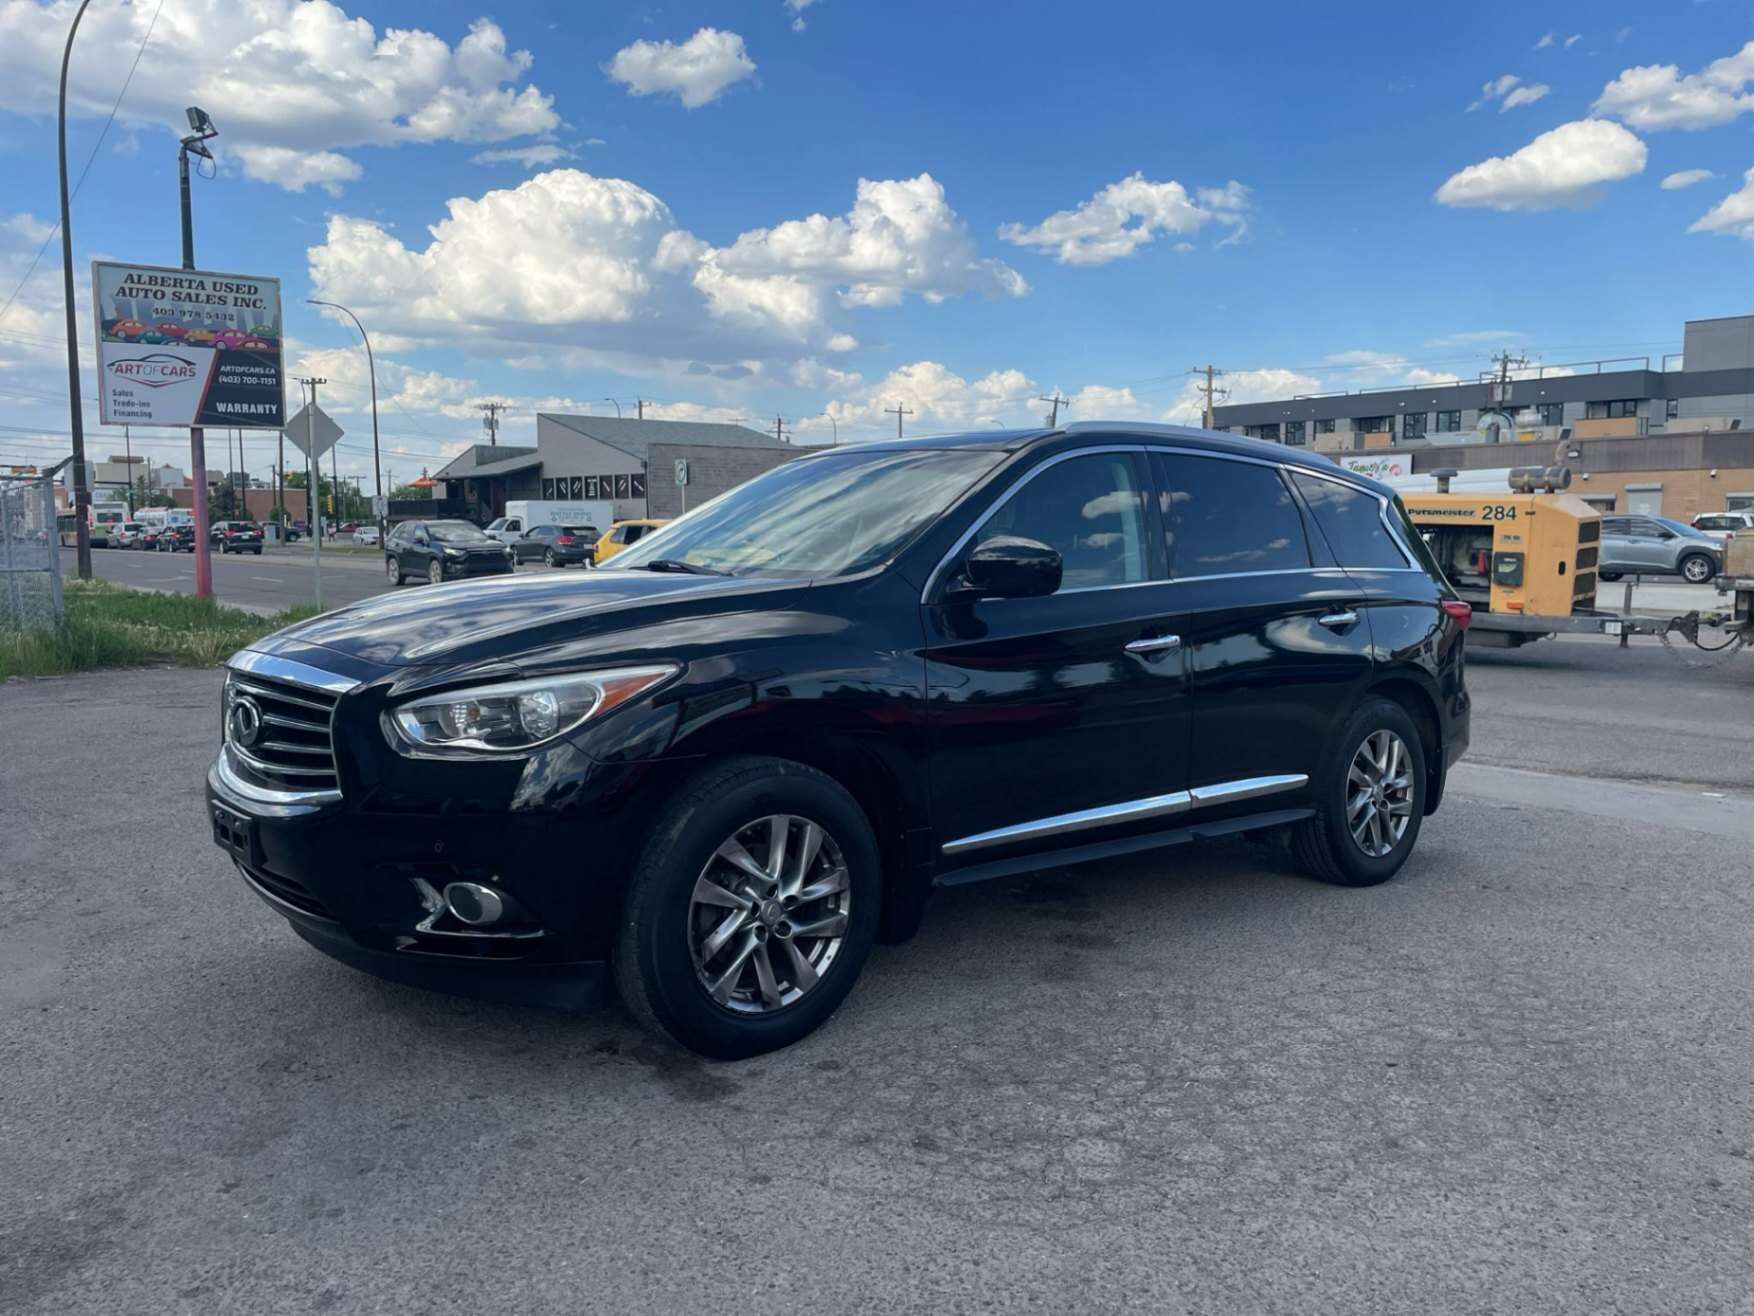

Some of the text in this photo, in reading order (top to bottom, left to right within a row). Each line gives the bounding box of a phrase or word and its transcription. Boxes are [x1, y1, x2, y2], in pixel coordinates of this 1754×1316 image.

[123, 273, 258, 296] ALBERTA USED
[115, 286, 267, 310] AUTO SALES INC.
[152, 307, 235, 321] 403 978 5432
[220, 365, 276, 375] ARTOFCARS.CA
[218, 375, 276, 385] (403) 700-1151
[112, 388, 134, 397] Sales
[112, 399, 151, 408] Trade-ins
[216, 402, 277, 414] WARRANTY
[113, 409, 152, 419] Financing
[1481, 505, 1517, 521] 284
